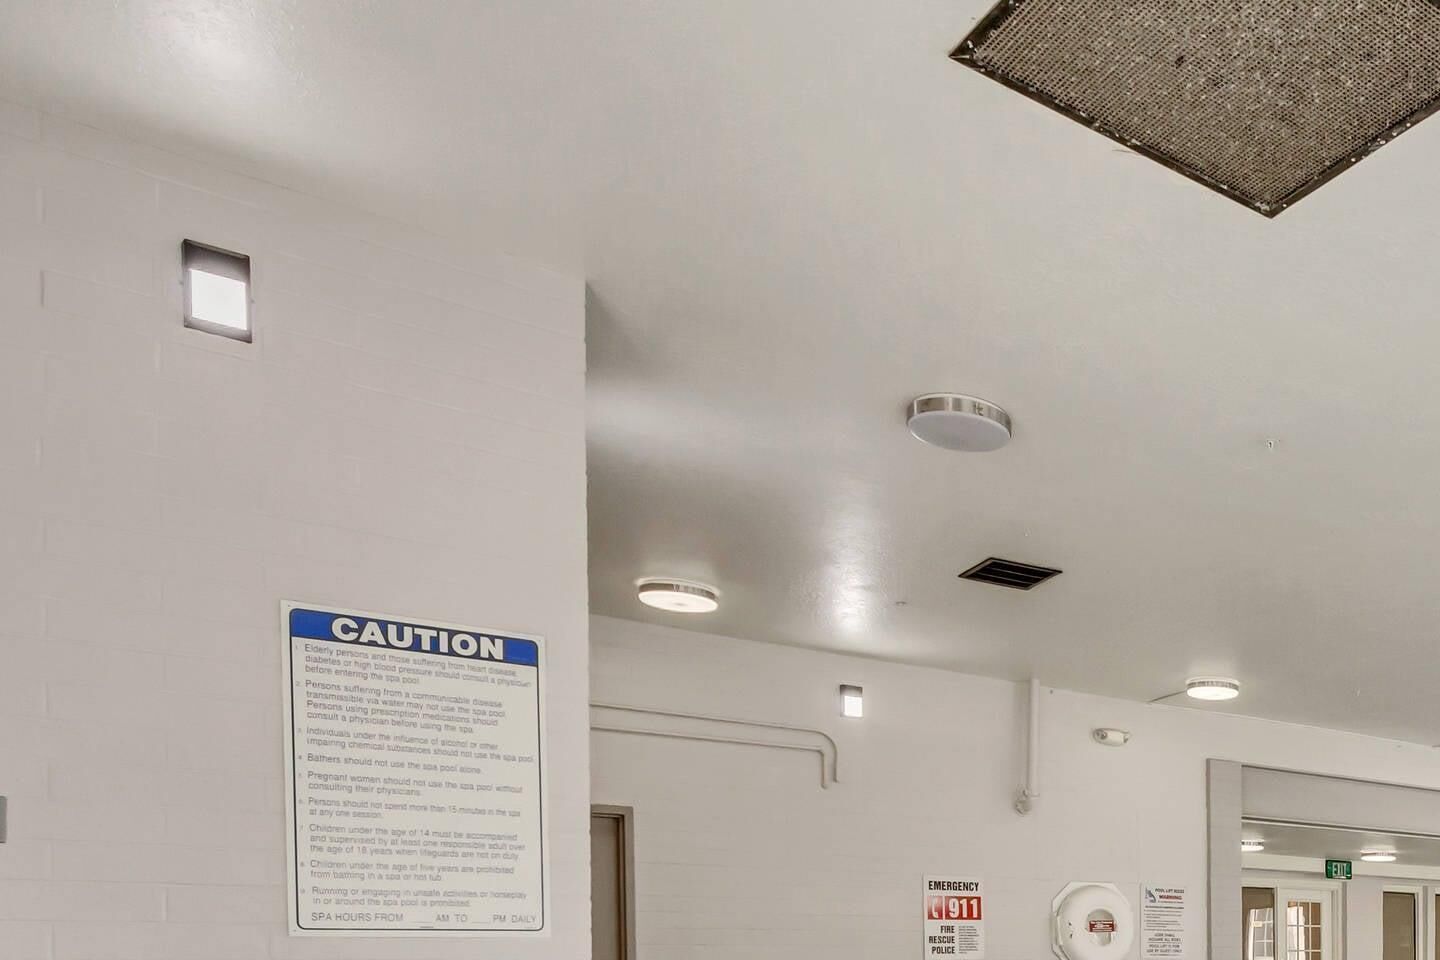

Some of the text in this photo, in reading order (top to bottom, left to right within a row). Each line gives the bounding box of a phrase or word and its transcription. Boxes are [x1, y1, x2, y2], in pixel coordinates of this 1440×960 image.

[331, 617, 504, 660] CAUTION
[305, 680, 341, 691] Persons
[307, 700, 343, 711] Persons
[308, 771, 348, 782] Pregnant
[928, 881, 979, 891] EMERGENCY
[948, 898, 978, 918] 911
[311, 913, 332, 921] SPA
[335, 913, 372, 921] HOURS
[375, 914, 404, 922] FROM
[436, 914, 449, 922] AM
[940, 925, 955, 933] FIRE
[932, 946, 955, 954] POLICE
